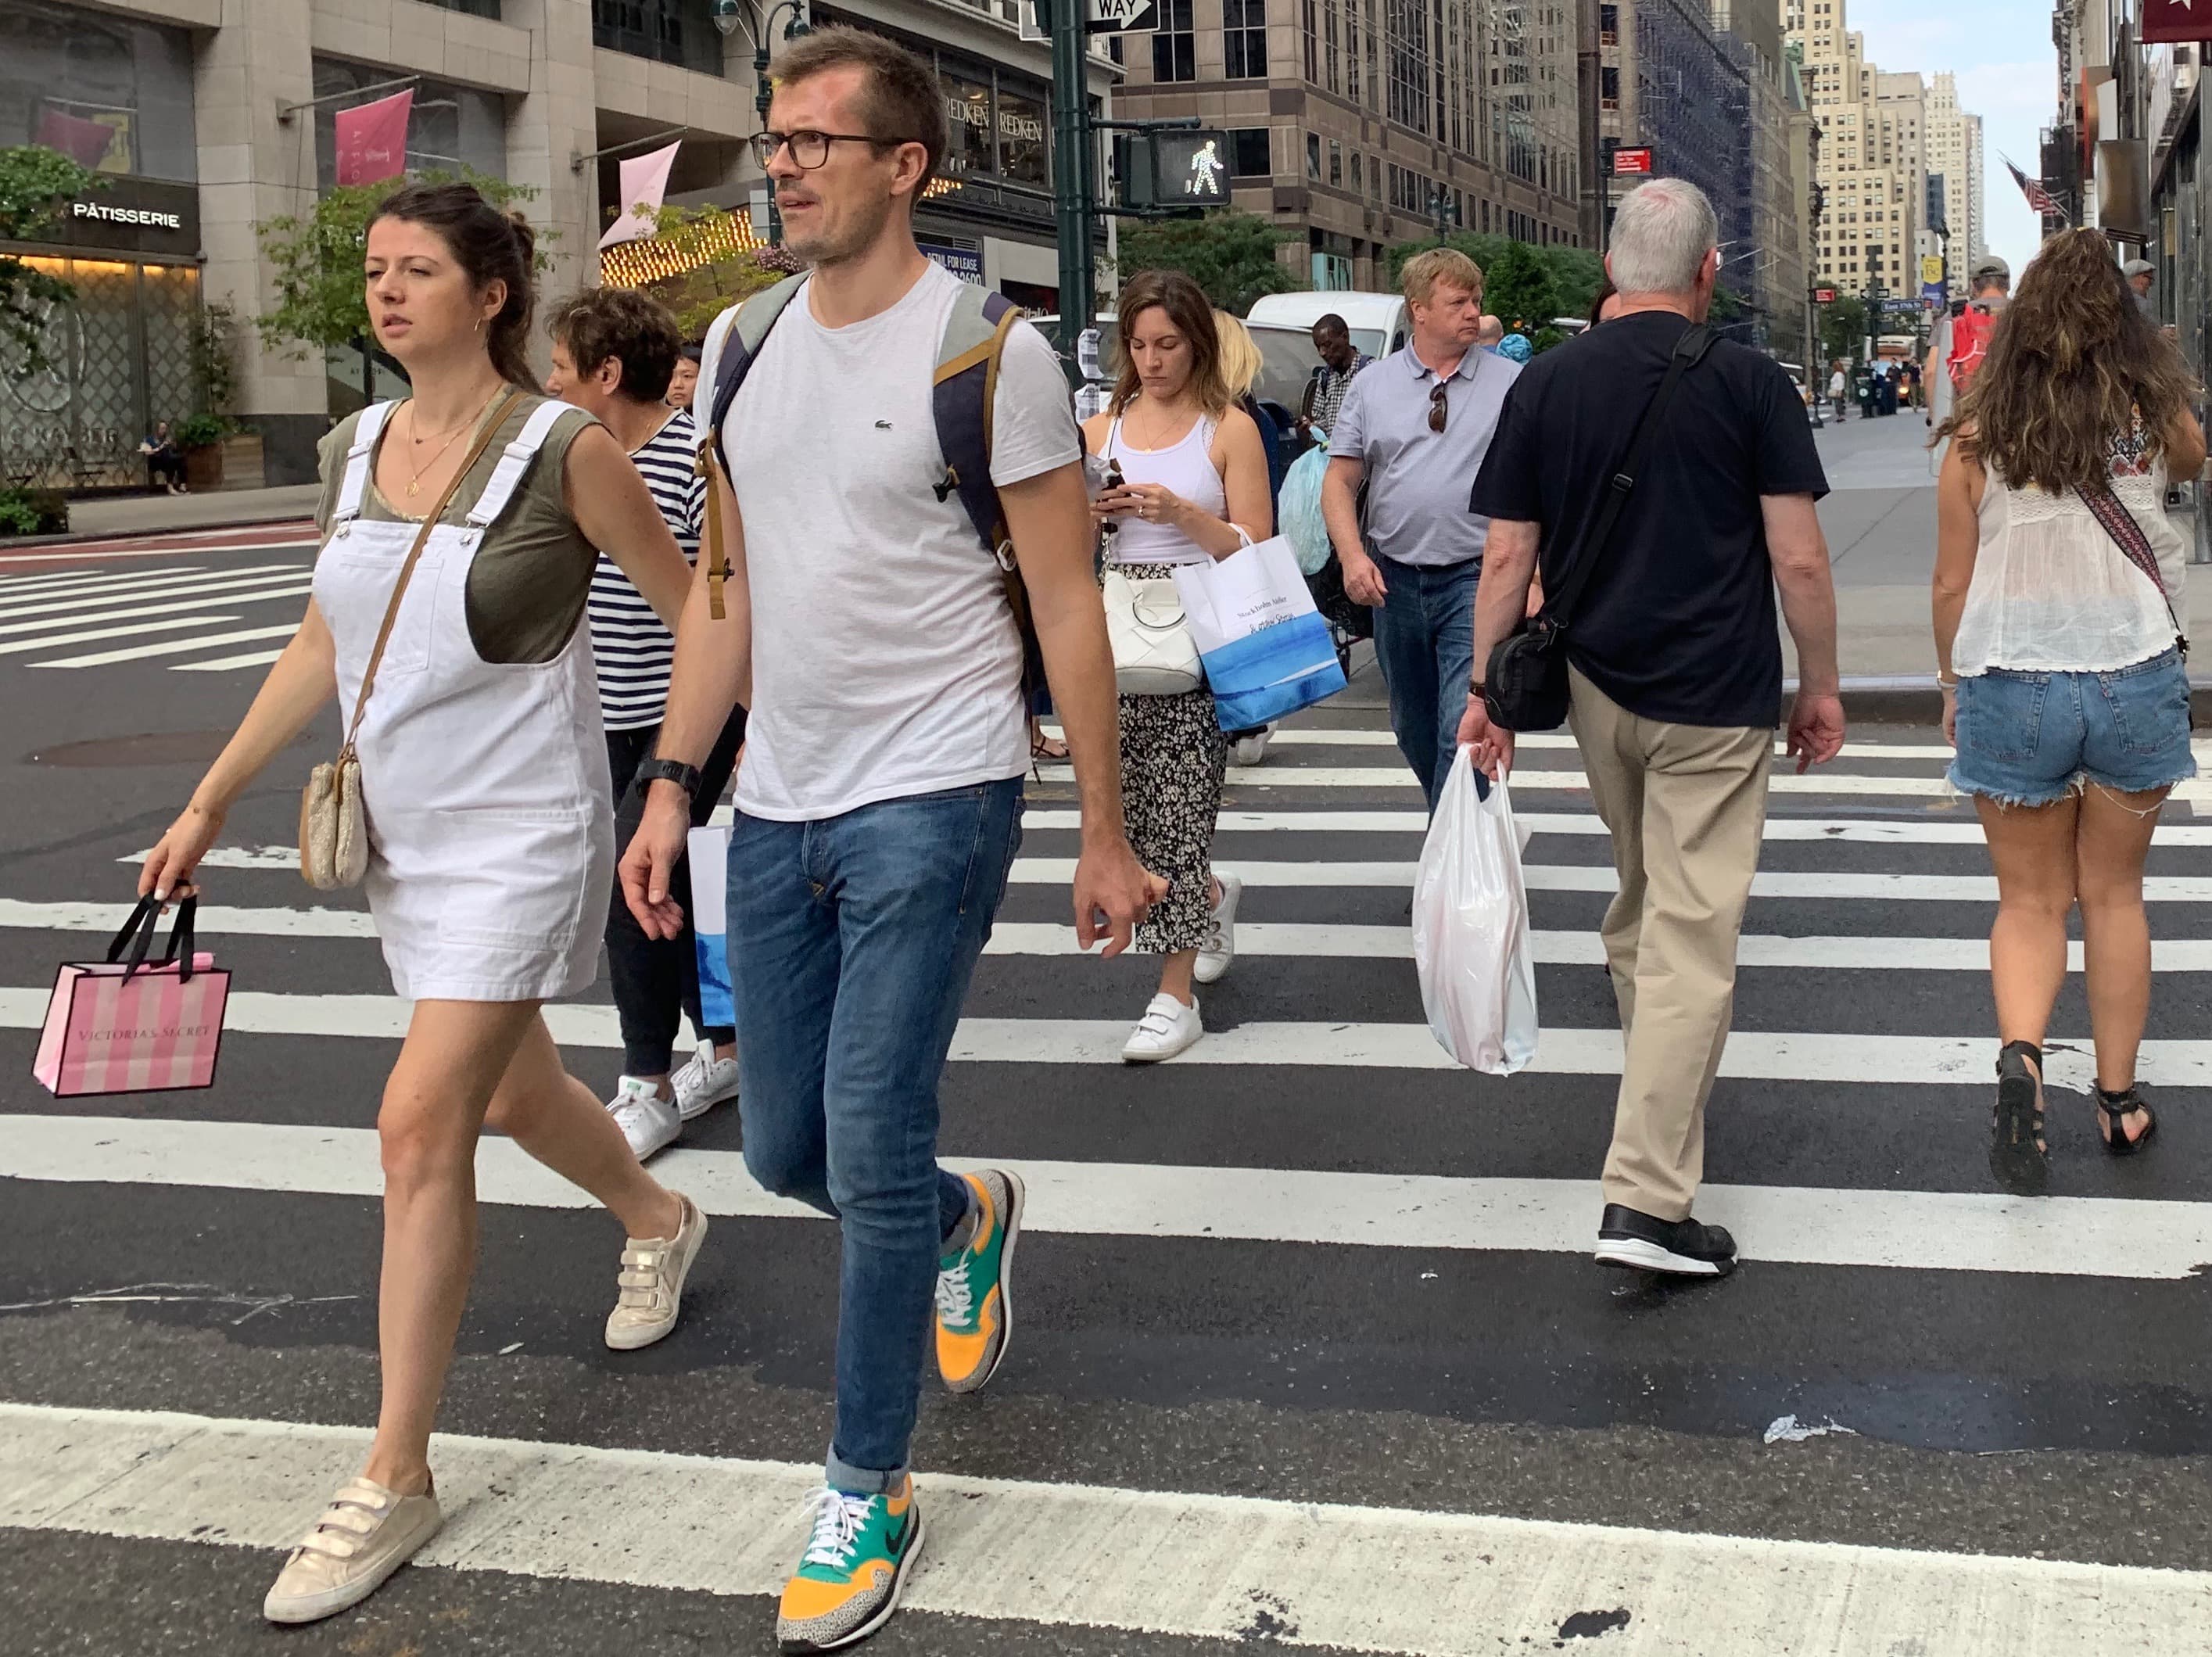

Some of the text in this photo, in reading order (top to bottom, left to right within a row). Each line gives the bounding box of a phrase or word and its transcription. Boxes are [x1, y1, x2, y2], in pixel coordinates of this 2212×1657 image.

[1099, 0, 1135, 18] WAY
[1000, 113, 1042, 142] REDKEN
[73, 202, 181, 228] PÂTISSERIE
[947, 255, 959, 269] FOR
[959, 256, 977, 271] LEASE
[163, 1026, 210, 1038] SECRET
